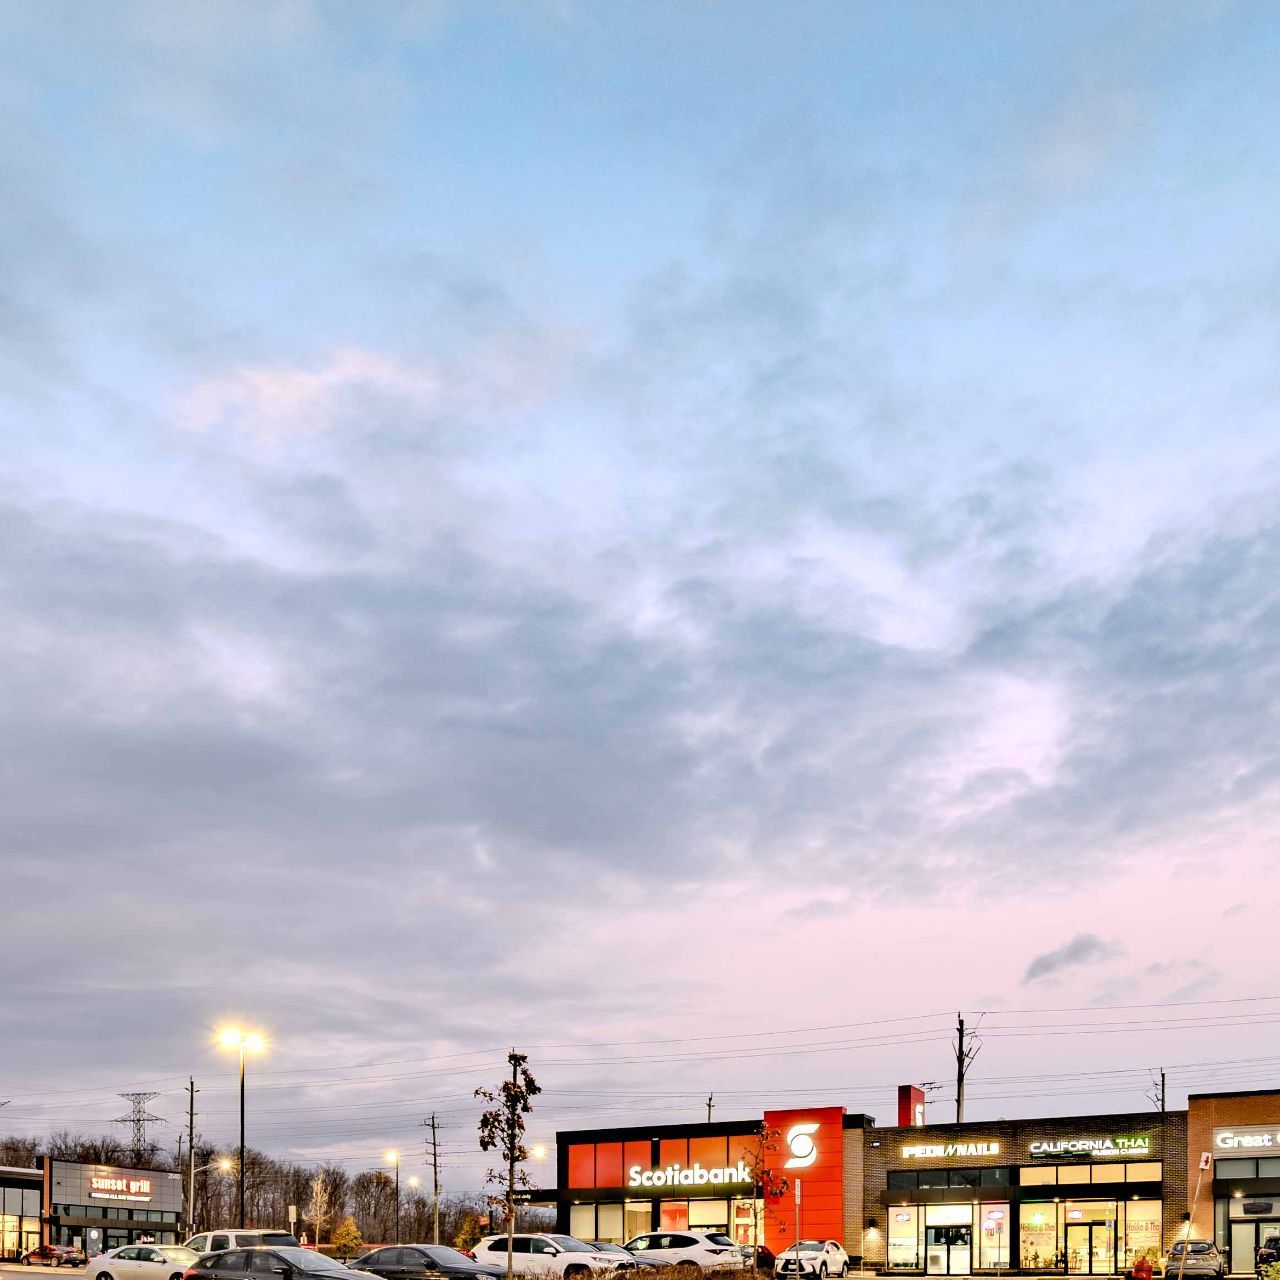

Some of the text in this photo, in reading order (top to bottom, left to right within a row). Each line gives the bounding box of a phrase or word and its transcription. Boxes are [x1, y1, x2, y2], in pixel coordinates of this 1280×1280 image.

[1030, 1137, 1149, 1153] CALIFORNIA THAI
[1216, 1132, 1272, 1148] Great
[628, 1160, 753, 1188] Scotiabank
[91, 1177, 151, 1193] sunset grill
